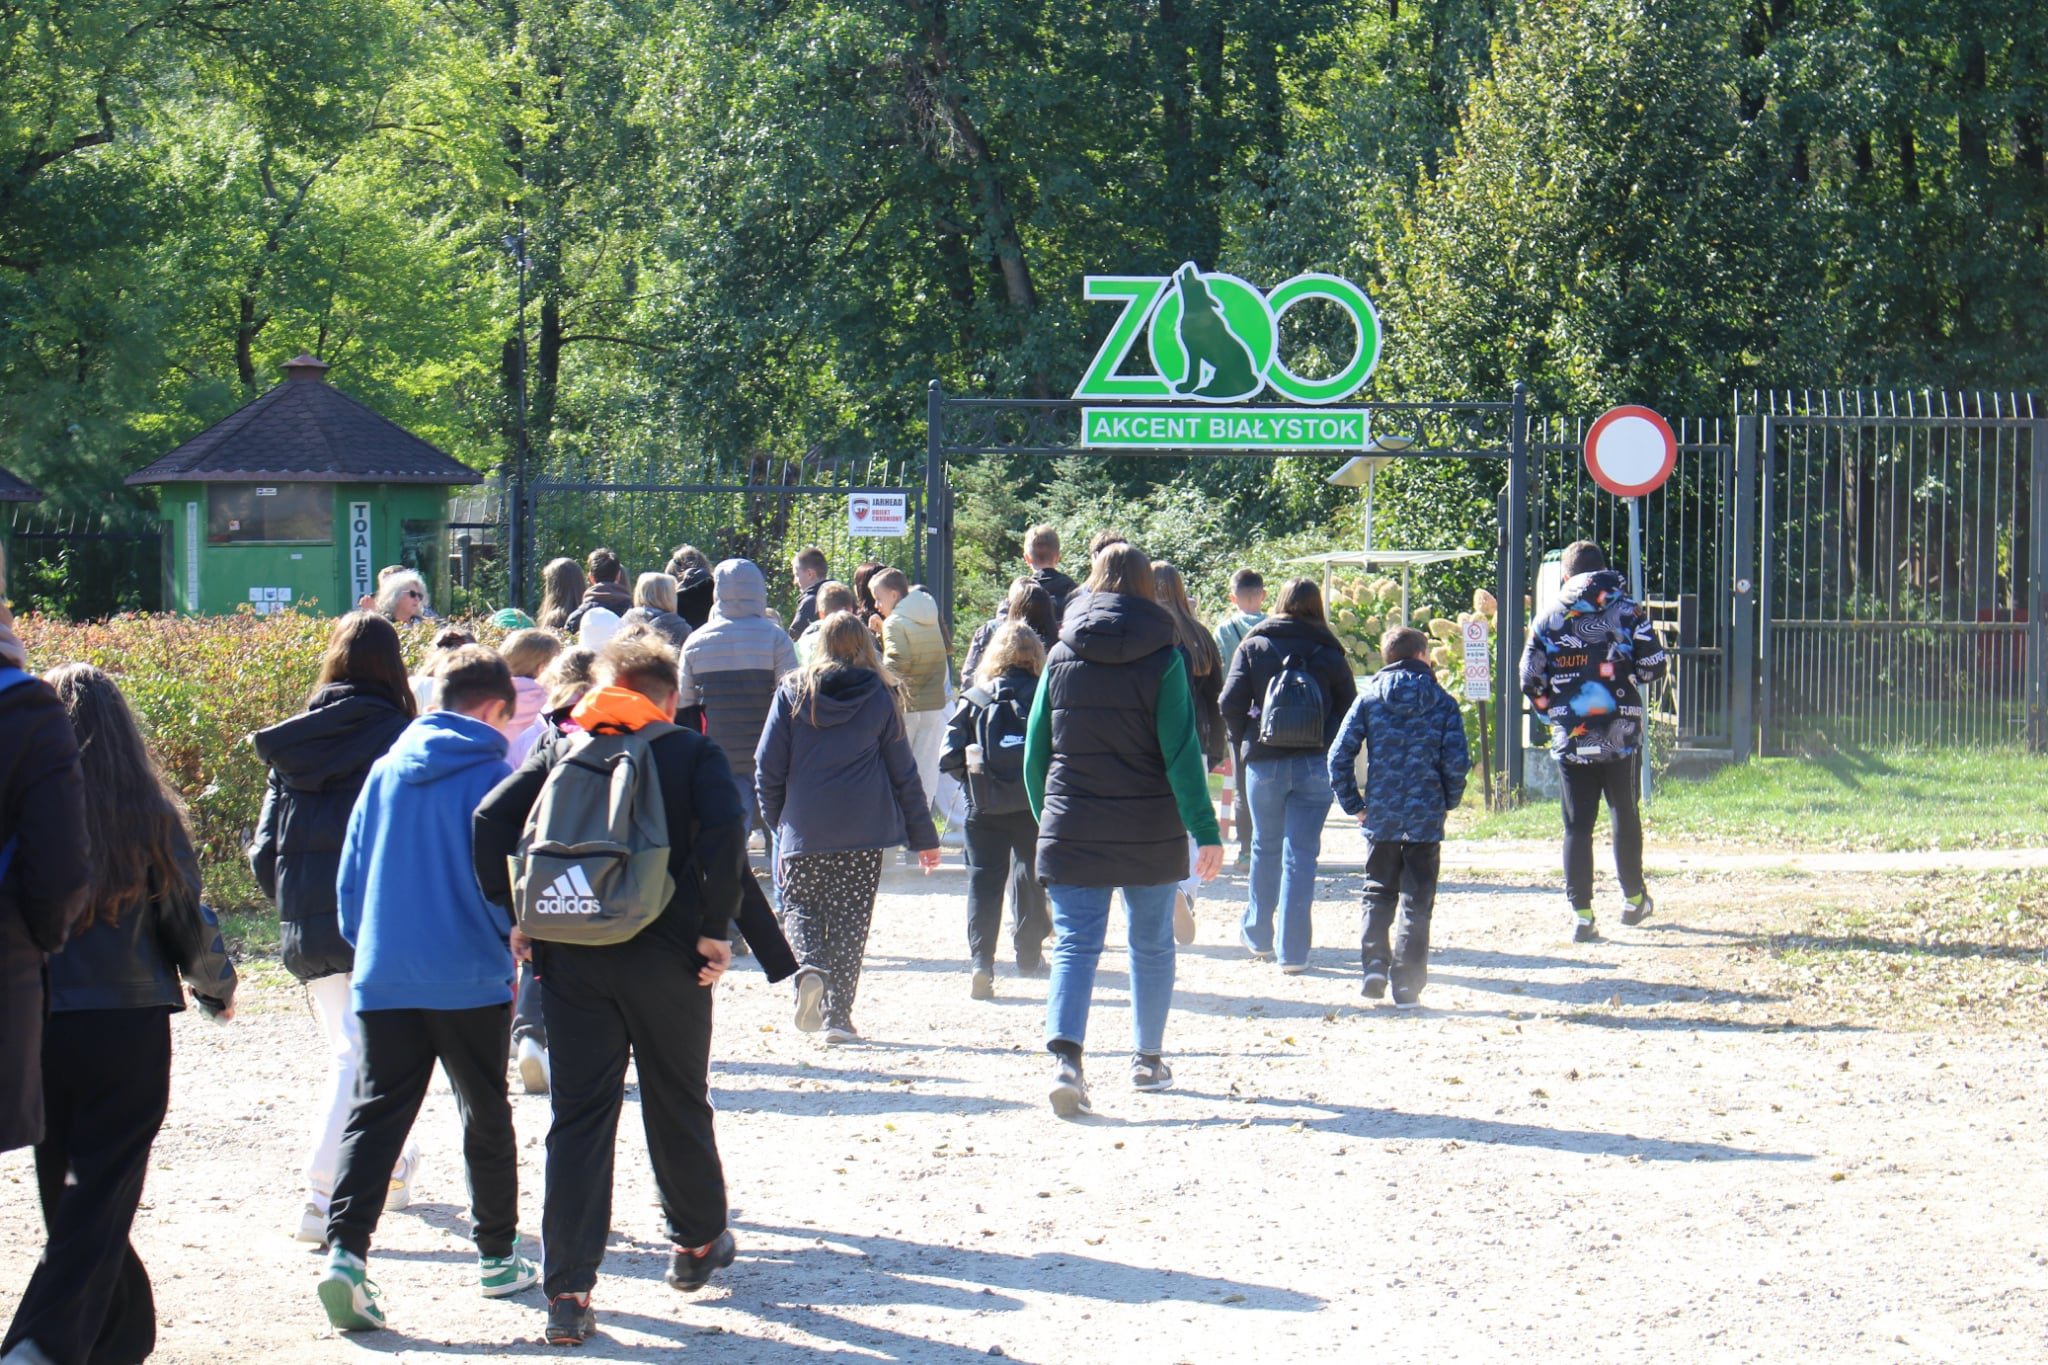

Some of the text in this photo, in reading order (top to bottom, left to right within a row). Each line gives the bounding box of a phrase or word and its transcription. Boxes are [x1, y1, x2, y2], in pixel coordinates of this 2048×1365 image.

[1071, 272, 1382, 404] ZOO
[1093, 417, 1358, 440] AKCENT BIAŁYSTOK
[354, 504, 368, 607] TOALET
[535, 896, 602, 914] adidas
